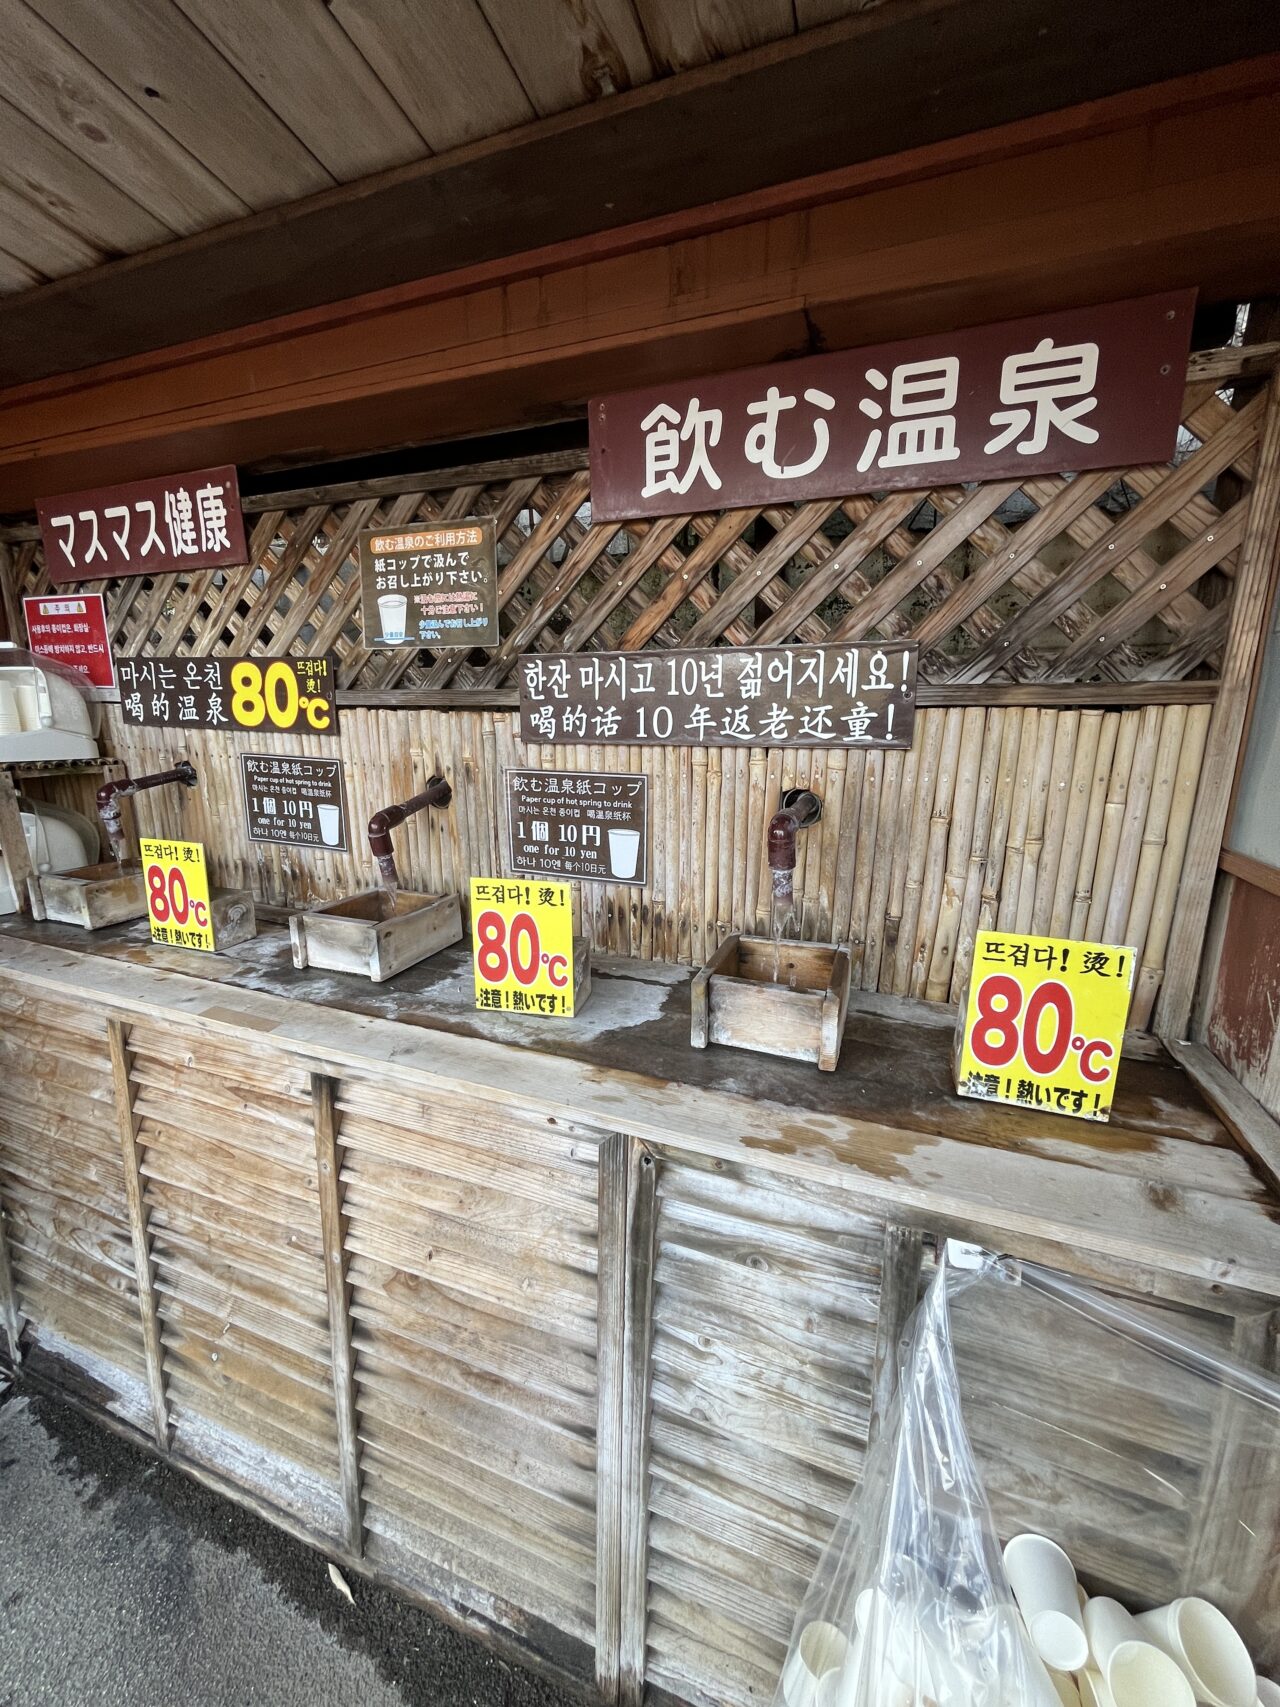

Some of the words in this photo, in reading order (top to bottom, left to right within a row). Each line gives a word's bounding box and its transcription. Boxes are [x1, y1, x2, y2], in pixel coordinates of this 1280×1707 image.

[641, 338, 1099, 498] 飲む温泉
[51, 483, 231, 567] マスマス健康
[375, 530, 478, 551] 飲む温泉のご利用方法
[374, 552, 470, 573] 紙コップで汲んで
[376, 570, 488, 590] お召し上がり下さい。
[120, 661, 176, 690] 마시는
[183, 661, 223, 690] 온천
[296, 659, 327, 677] 뜨겁다!
[523, 658, 571, 700] 한잔
[579, 656, 656, 701] 마시고
[666, 654, 724, 698] 10년
[736, 649, 910, 699] 젊어지세요!
[124, 692, 229, 726] 喝的温泉
[246, 759, 337, 778] 飲む温泉紙コップ
[253, 775, 269, 783] Paper
[269, 777, 279, 785] cup
[285, 777, 294, 785] hot
[295, 779, 311, 787] spring
[512, 776, 643, 796] 飲む温泉紙コップ
[518, 806, 540, 815] 마시는
[542, 807, 557, 817] 온천
[558, 808, 581, 818] 종이컵
[521, 795, 541, 804] Paper
[543, 797, 555, 805] cup
[557, 796, 564, 804] of
[565, 797, 578, 805] hot
[579, 799, 602, 808] spring
[603, 799, 611, 807] to
[613, 800, 633, 809] drink
[257, 817, 270, 825] one
[273, 816, 285, 827] for
[288, 818, 297, 828] 10
[300, 820, 312, 830] yen
[144, 844, 179, 861] 뜨겁다!
[516, 856, 537, 867] 하나
[523, 844, 540, 854] one
[544, 844, 559, 856] for
[564, 846, 576, 857] 10
[580, 849, 597, 860] yen
[476, 884, 530, 906] 뜨겁다!
[982, 941, 1070, 972] 뜨겁다!
[479, 988, 566, 1014] 注意！熱いです！
